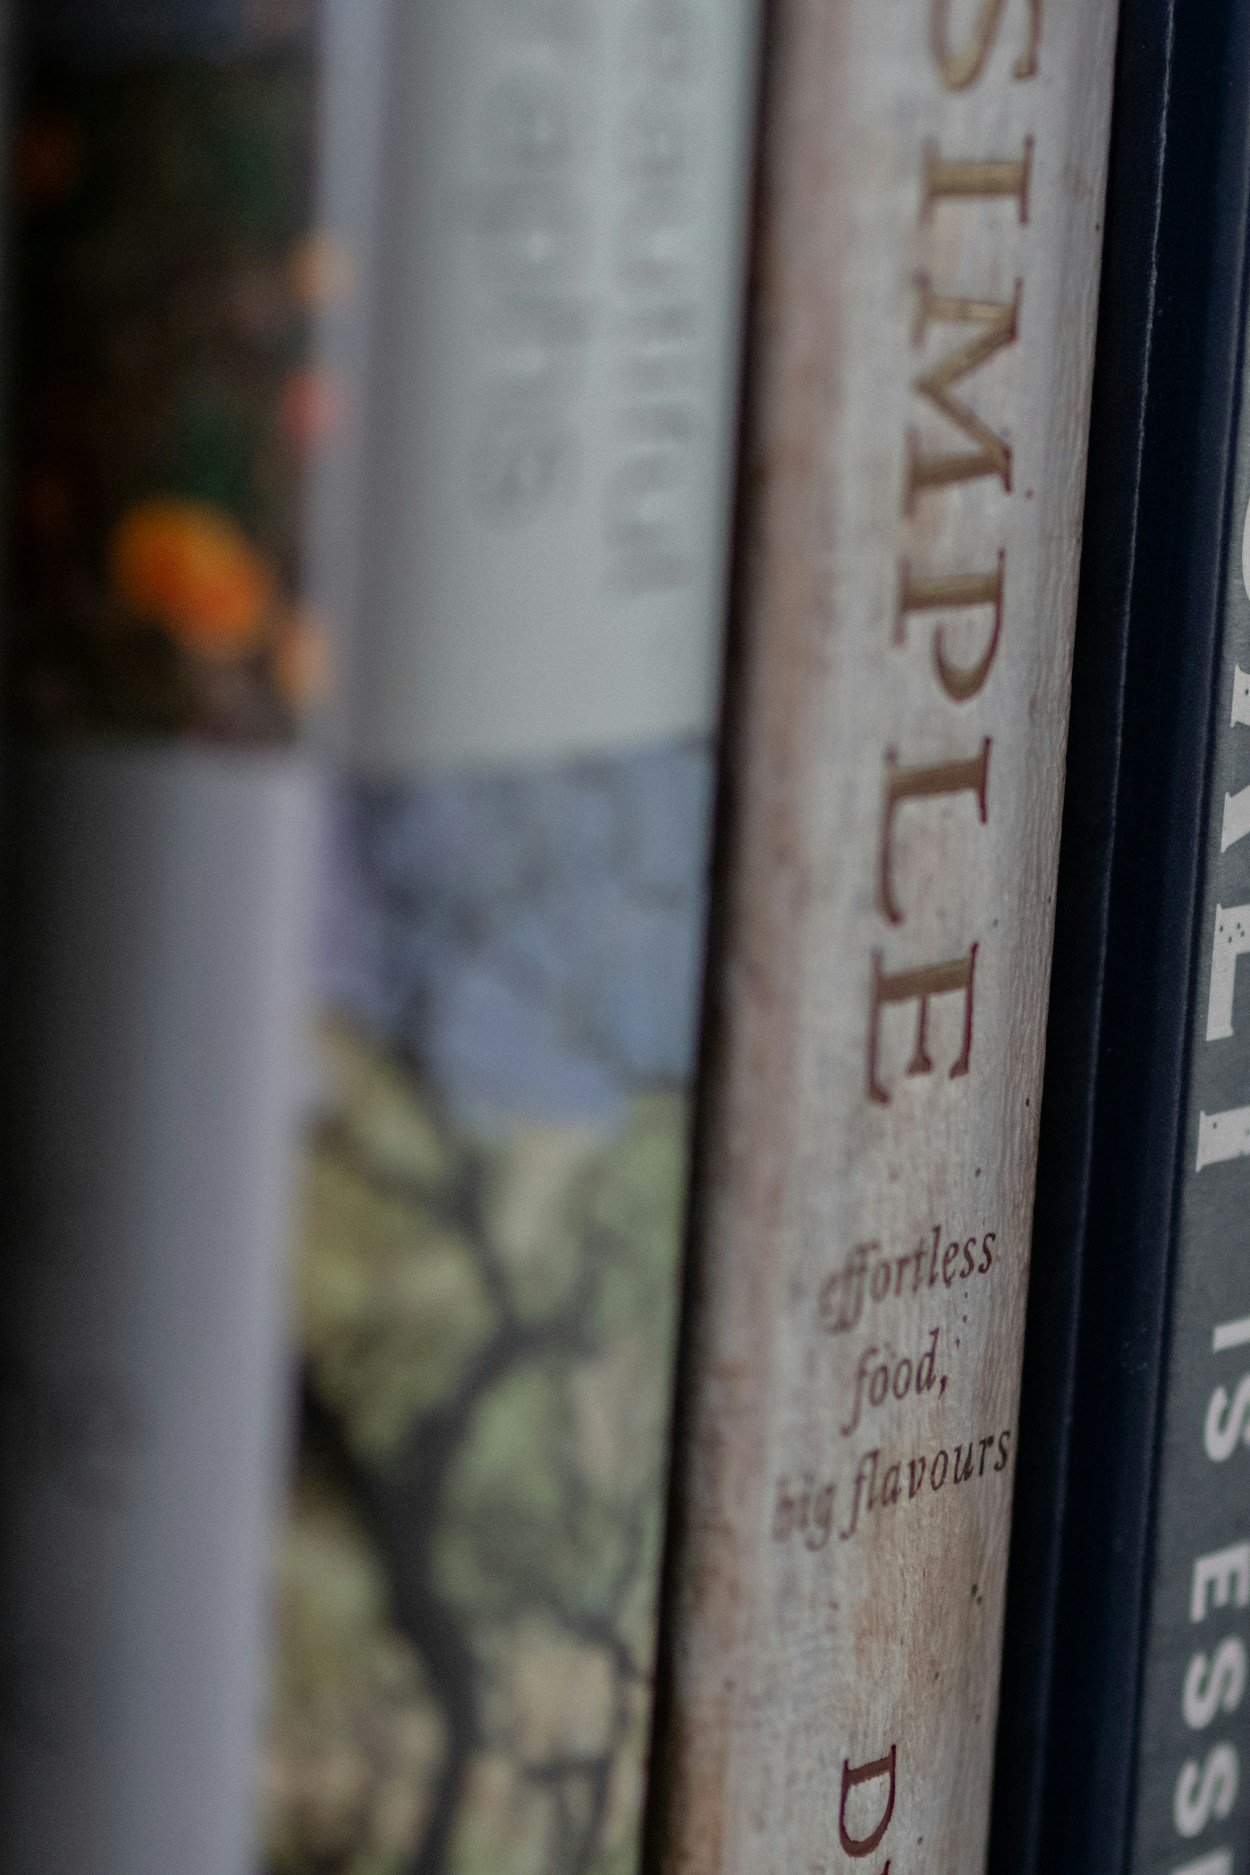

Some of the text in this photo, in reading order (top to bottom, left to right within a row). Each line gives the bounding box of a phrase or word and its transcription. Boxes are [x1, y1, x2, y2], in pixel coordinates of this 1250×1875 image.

[867, 0, 1041, 1104] SIMPLE
[817, 1225, 997, 1335] effortless
[839, 1326, 949, 1438] food,
[770, 1429, 1012, 1552] big flavours
